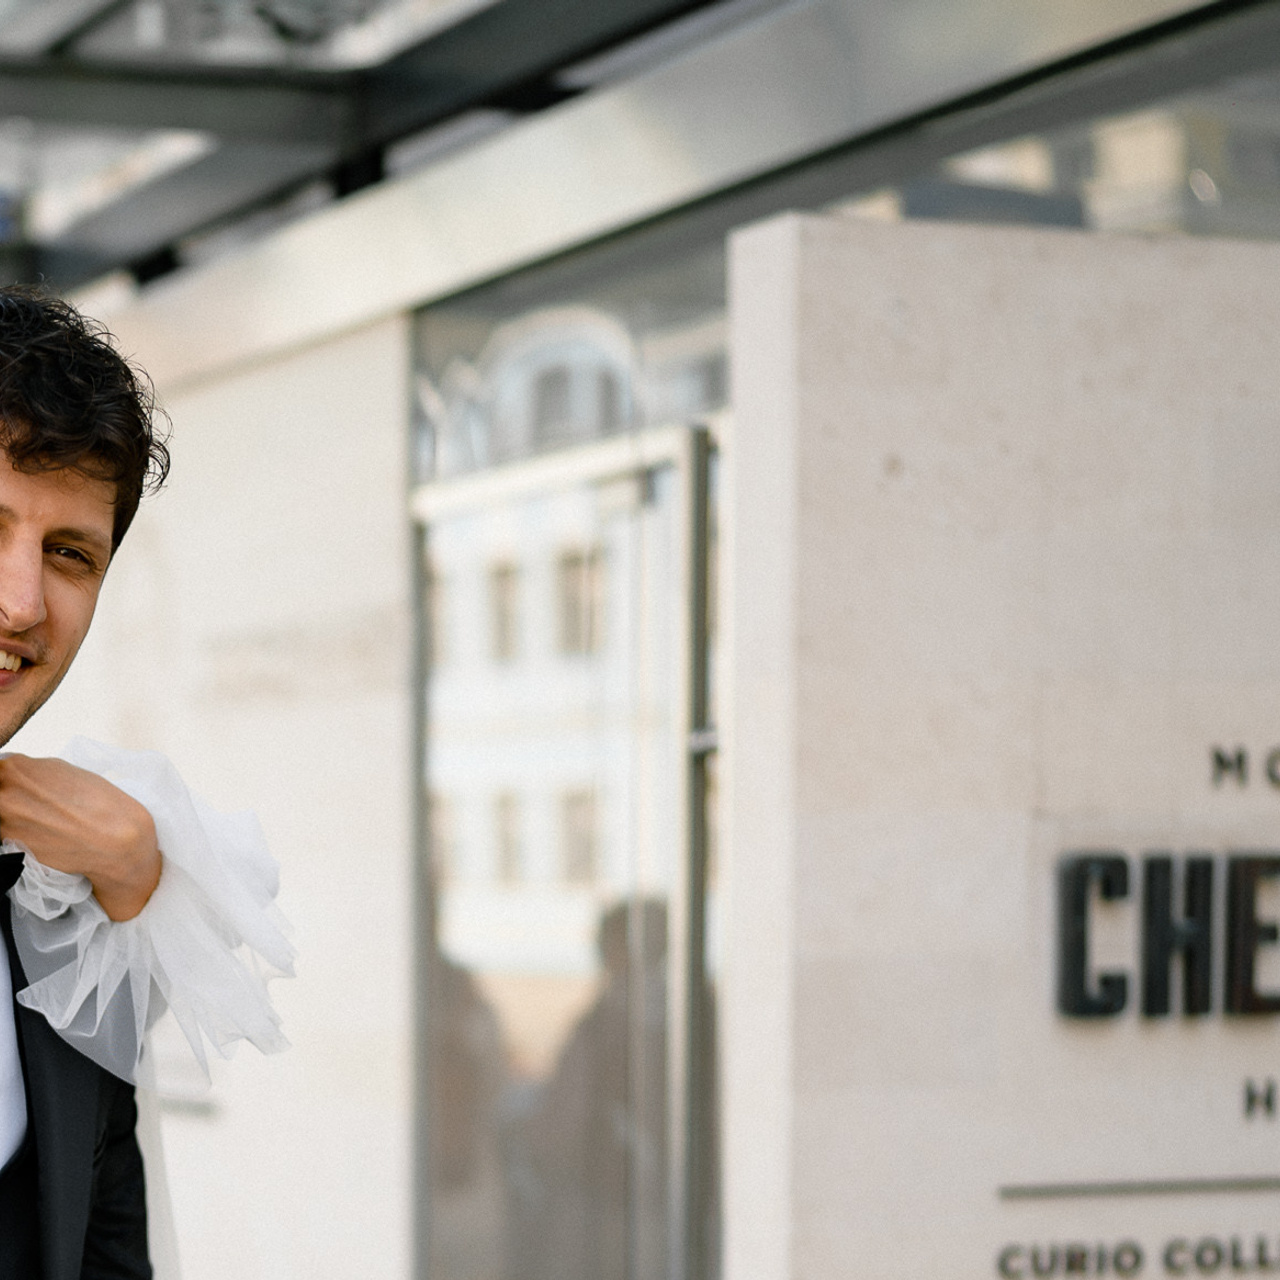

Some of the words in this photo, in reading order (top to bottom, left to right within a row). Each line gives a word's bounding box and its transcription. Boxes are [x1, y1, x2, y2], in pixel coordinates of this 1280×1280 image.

[1057, 852, 1280, 1018] CHE
[1244, 1077, 1277, 1121] H
[998, 1240, 1143, 1280] CURIO
